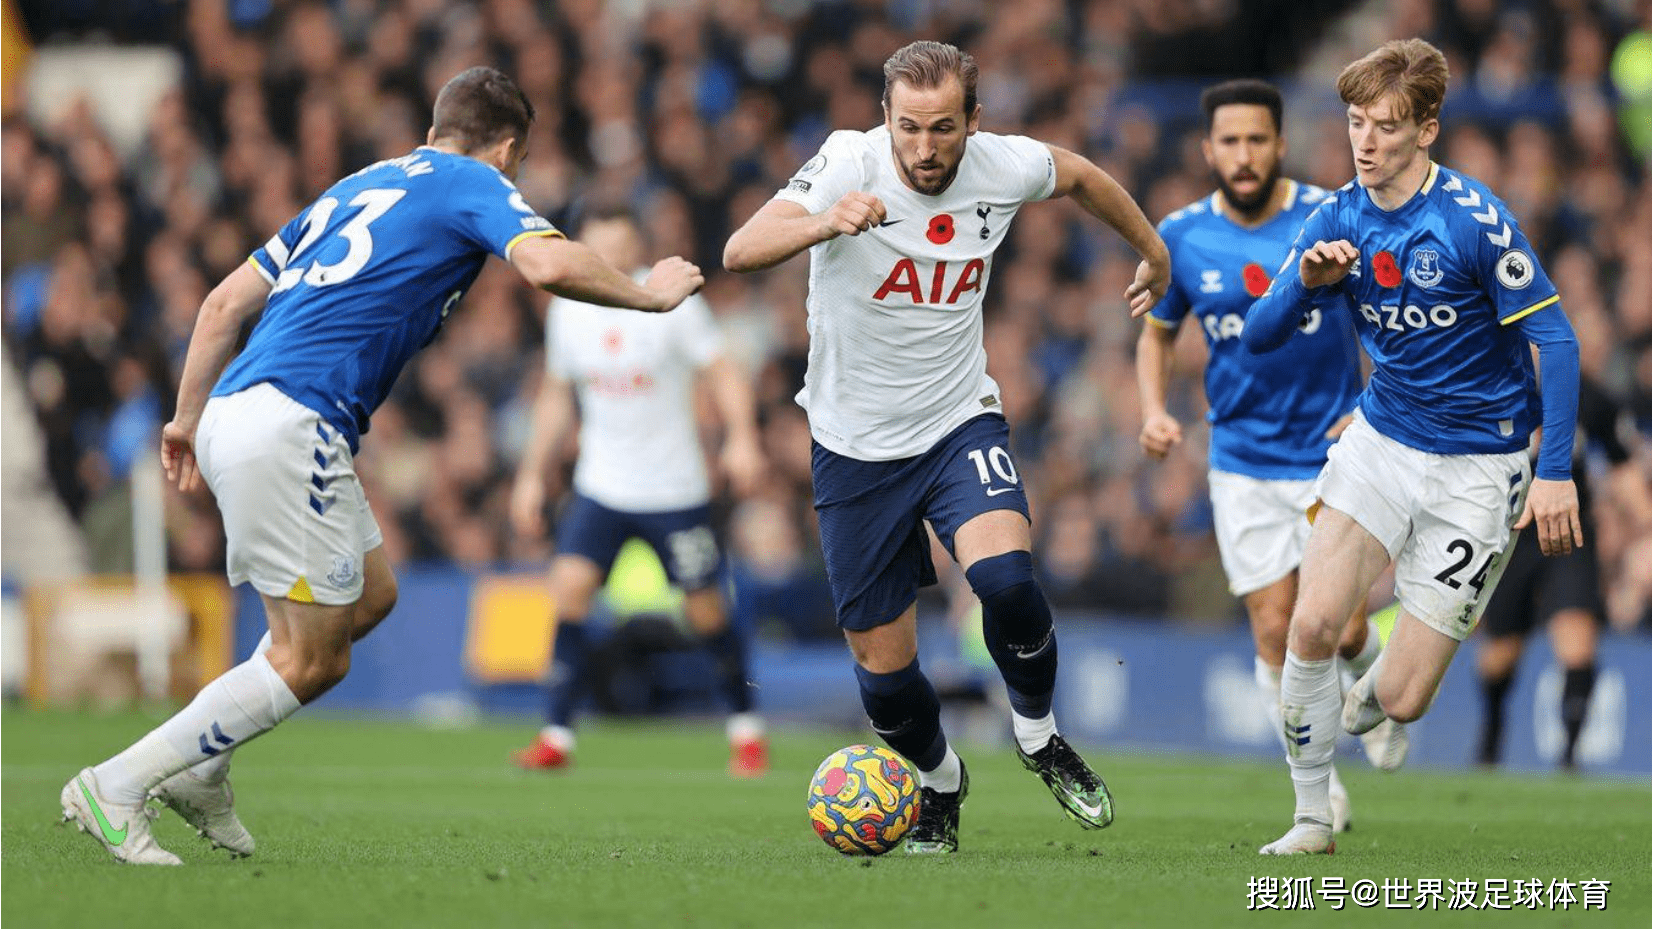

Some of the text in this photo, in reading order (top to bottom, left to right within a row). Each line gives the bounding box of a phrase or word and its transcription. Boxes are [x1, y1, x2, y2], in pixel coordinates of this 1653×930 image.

[268, 188, 407, 301] 23
[872, 258, 985, 304] AIA
[1360, 304, 1457, 332] AZOO
[967, 446, 1018, 485] 10
[1433, 539, 1495, 601] 24
